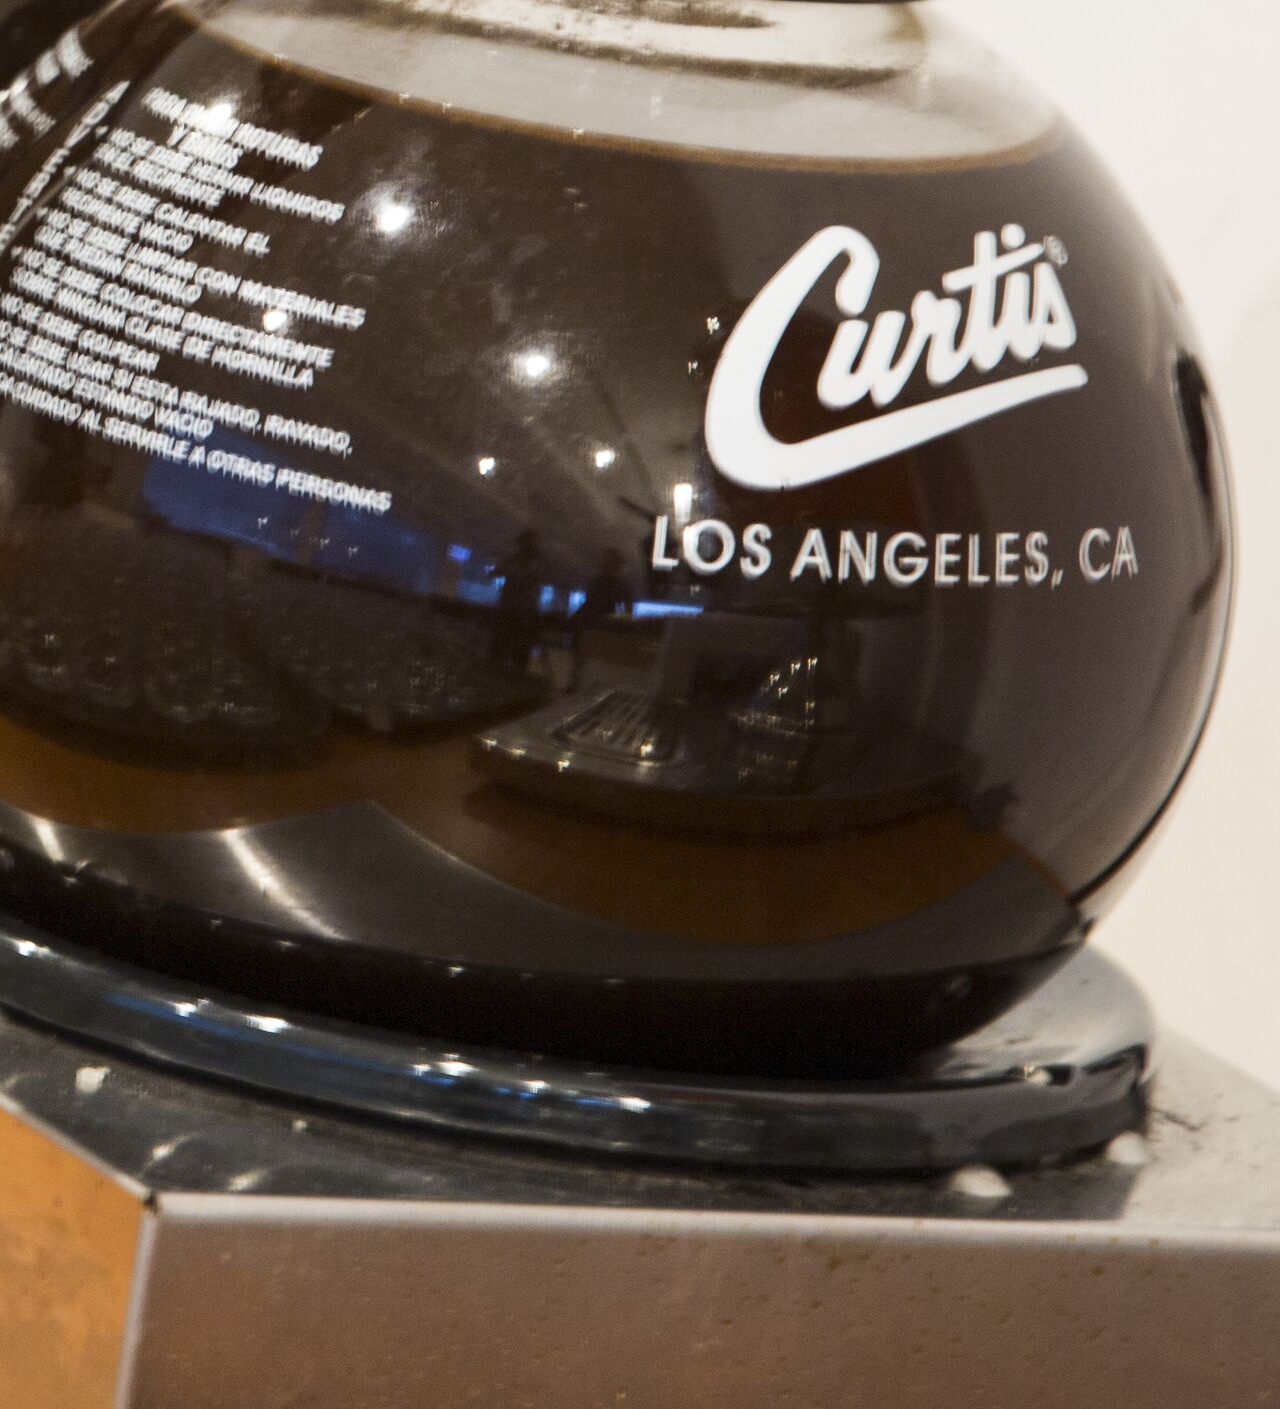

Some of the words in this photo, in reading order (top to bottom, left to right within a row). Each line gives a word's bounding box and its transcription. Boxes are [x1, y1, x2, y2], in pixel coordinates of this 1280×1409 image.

[154, 202, 248, 249] CALENTAR
[243, 231, 271, 258] EL
[249, 182, 345, 224] LIQUIDOS
[139, 219, 194, 258] VACIO
[100, 282, 186, 328] COLOCAR
[181, 310, 335, 372] DIRECTAMENTE
[194, 266, 241, 296] CON
[237, 278, 367, 331] MATERIALES
[182, 335, 215, 363] DE
[211, 344, 314, 391] HORNILLA
[705, 224, 1088, 489] Curtis
[154, 404, 214, 443] VACIO
[188, 443, 206, 470] A
[206, 449, 276, 488] OTRAS
[275, 467, 392, 515] PERSONAS
[652, 514, 772, 580] LOS
[791, 528, 1063, 589] ANGELES,
[1080, 526, 1138, 581] CA
